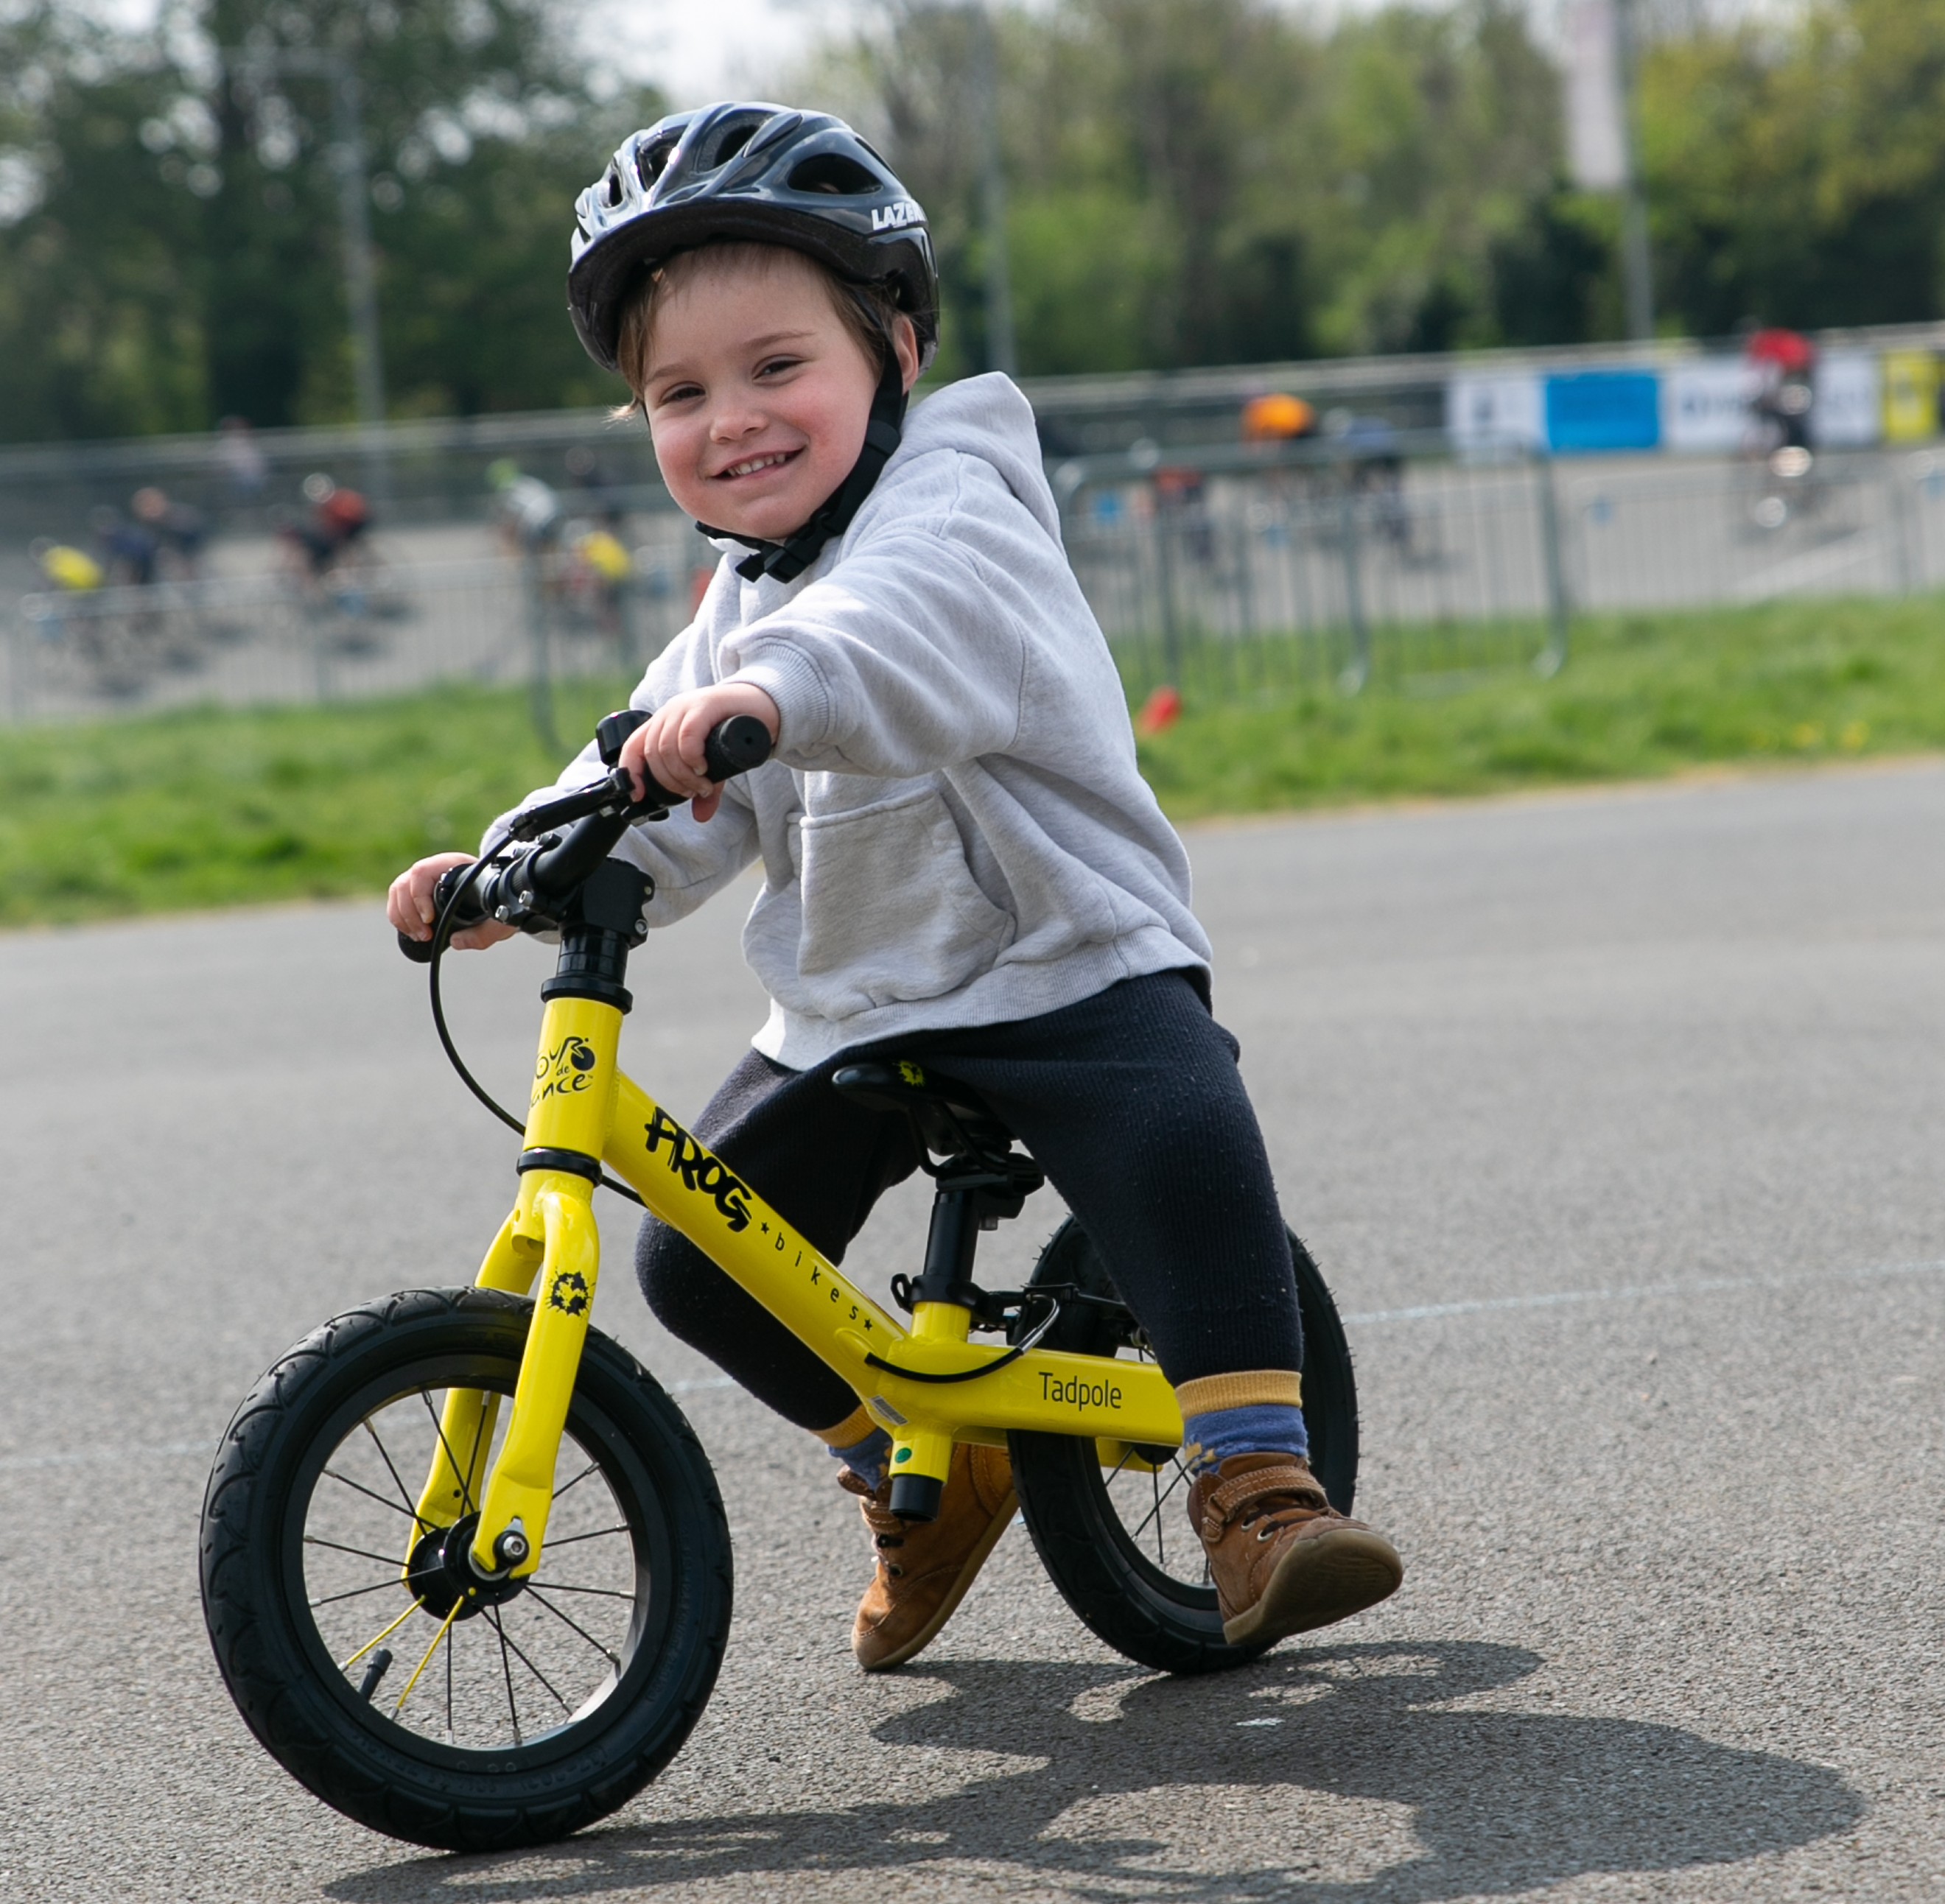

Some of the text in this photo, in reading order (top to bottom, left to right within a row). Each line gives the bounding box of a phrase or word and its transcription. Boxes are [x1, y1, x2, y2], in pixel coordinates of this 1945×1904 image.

[557, 1063, 570, 1076] de
[644, 1106, 859, 1321] FROG bikes
[1038, 1371, 1122, 1412] Tadpole
